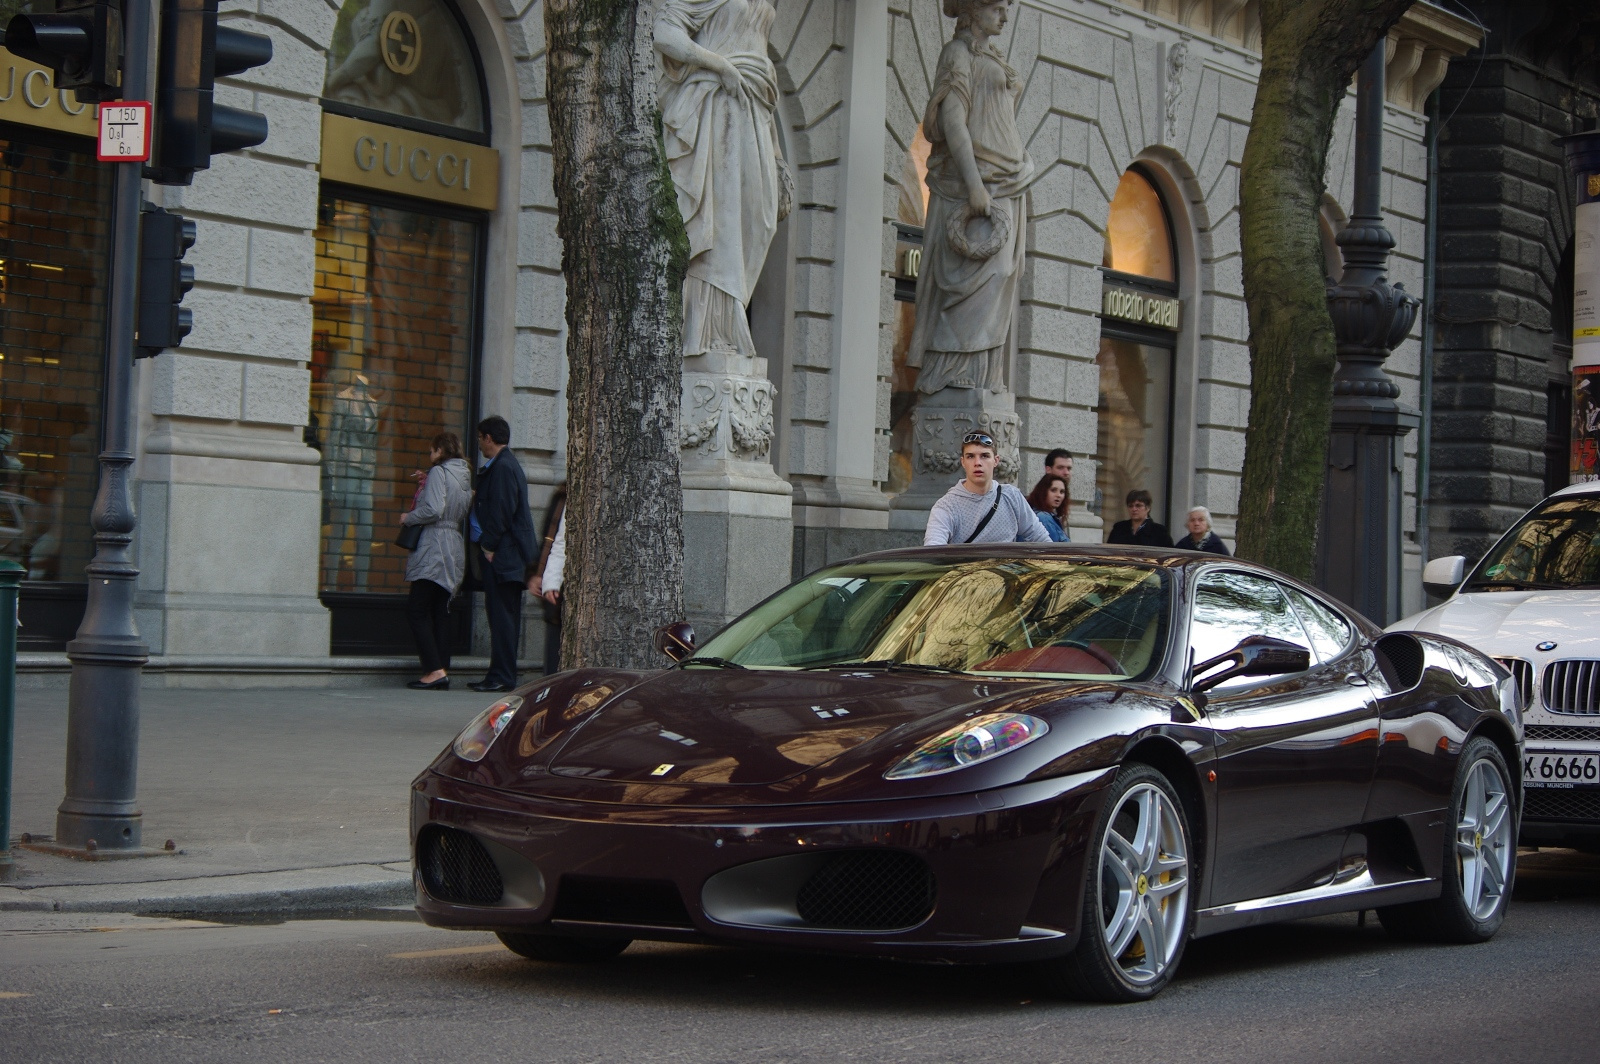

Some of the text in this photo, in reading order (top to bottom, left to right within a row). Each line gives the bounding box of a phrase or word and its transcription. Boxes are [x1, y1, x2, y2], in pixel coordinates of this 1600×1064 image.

[106, 108, 136, 121] T 150
[355, 135, 471, 191] GUCCI
[1105, 288, 1179, 328] roberto cavalli
[1541, 757, 1596, 779] 6666
